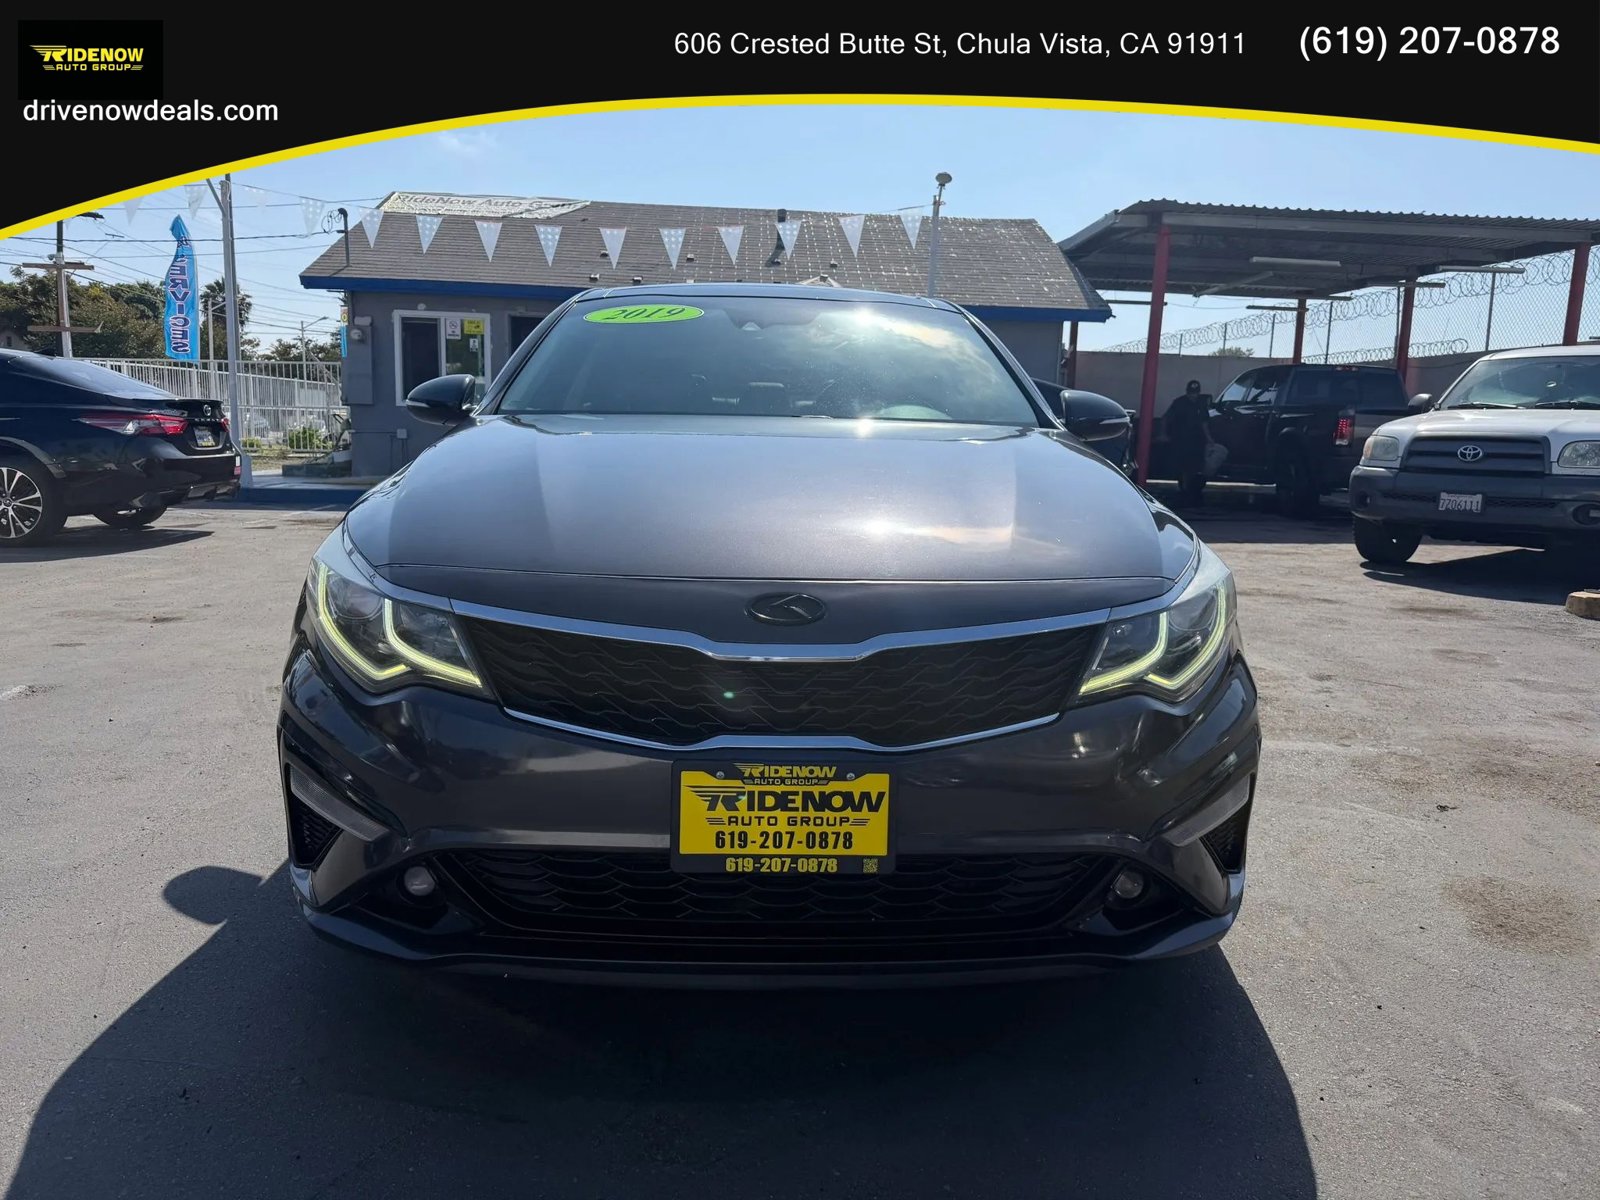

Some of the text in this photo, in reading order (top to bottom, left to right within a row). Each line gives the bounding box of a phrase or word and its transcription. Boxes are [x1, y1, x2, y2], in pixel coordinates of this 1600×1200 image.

[603, 307, 686, 320] 2019
[733, 763, 837, 778] RIDENOW
[684, 786, 886, 813] RIDENOW
[727, 816, 850, 827] AUTO GROUP
[714, 831, 854, 849] 619-207-0878
[725, 857, 838, 873] 619-207-0878
